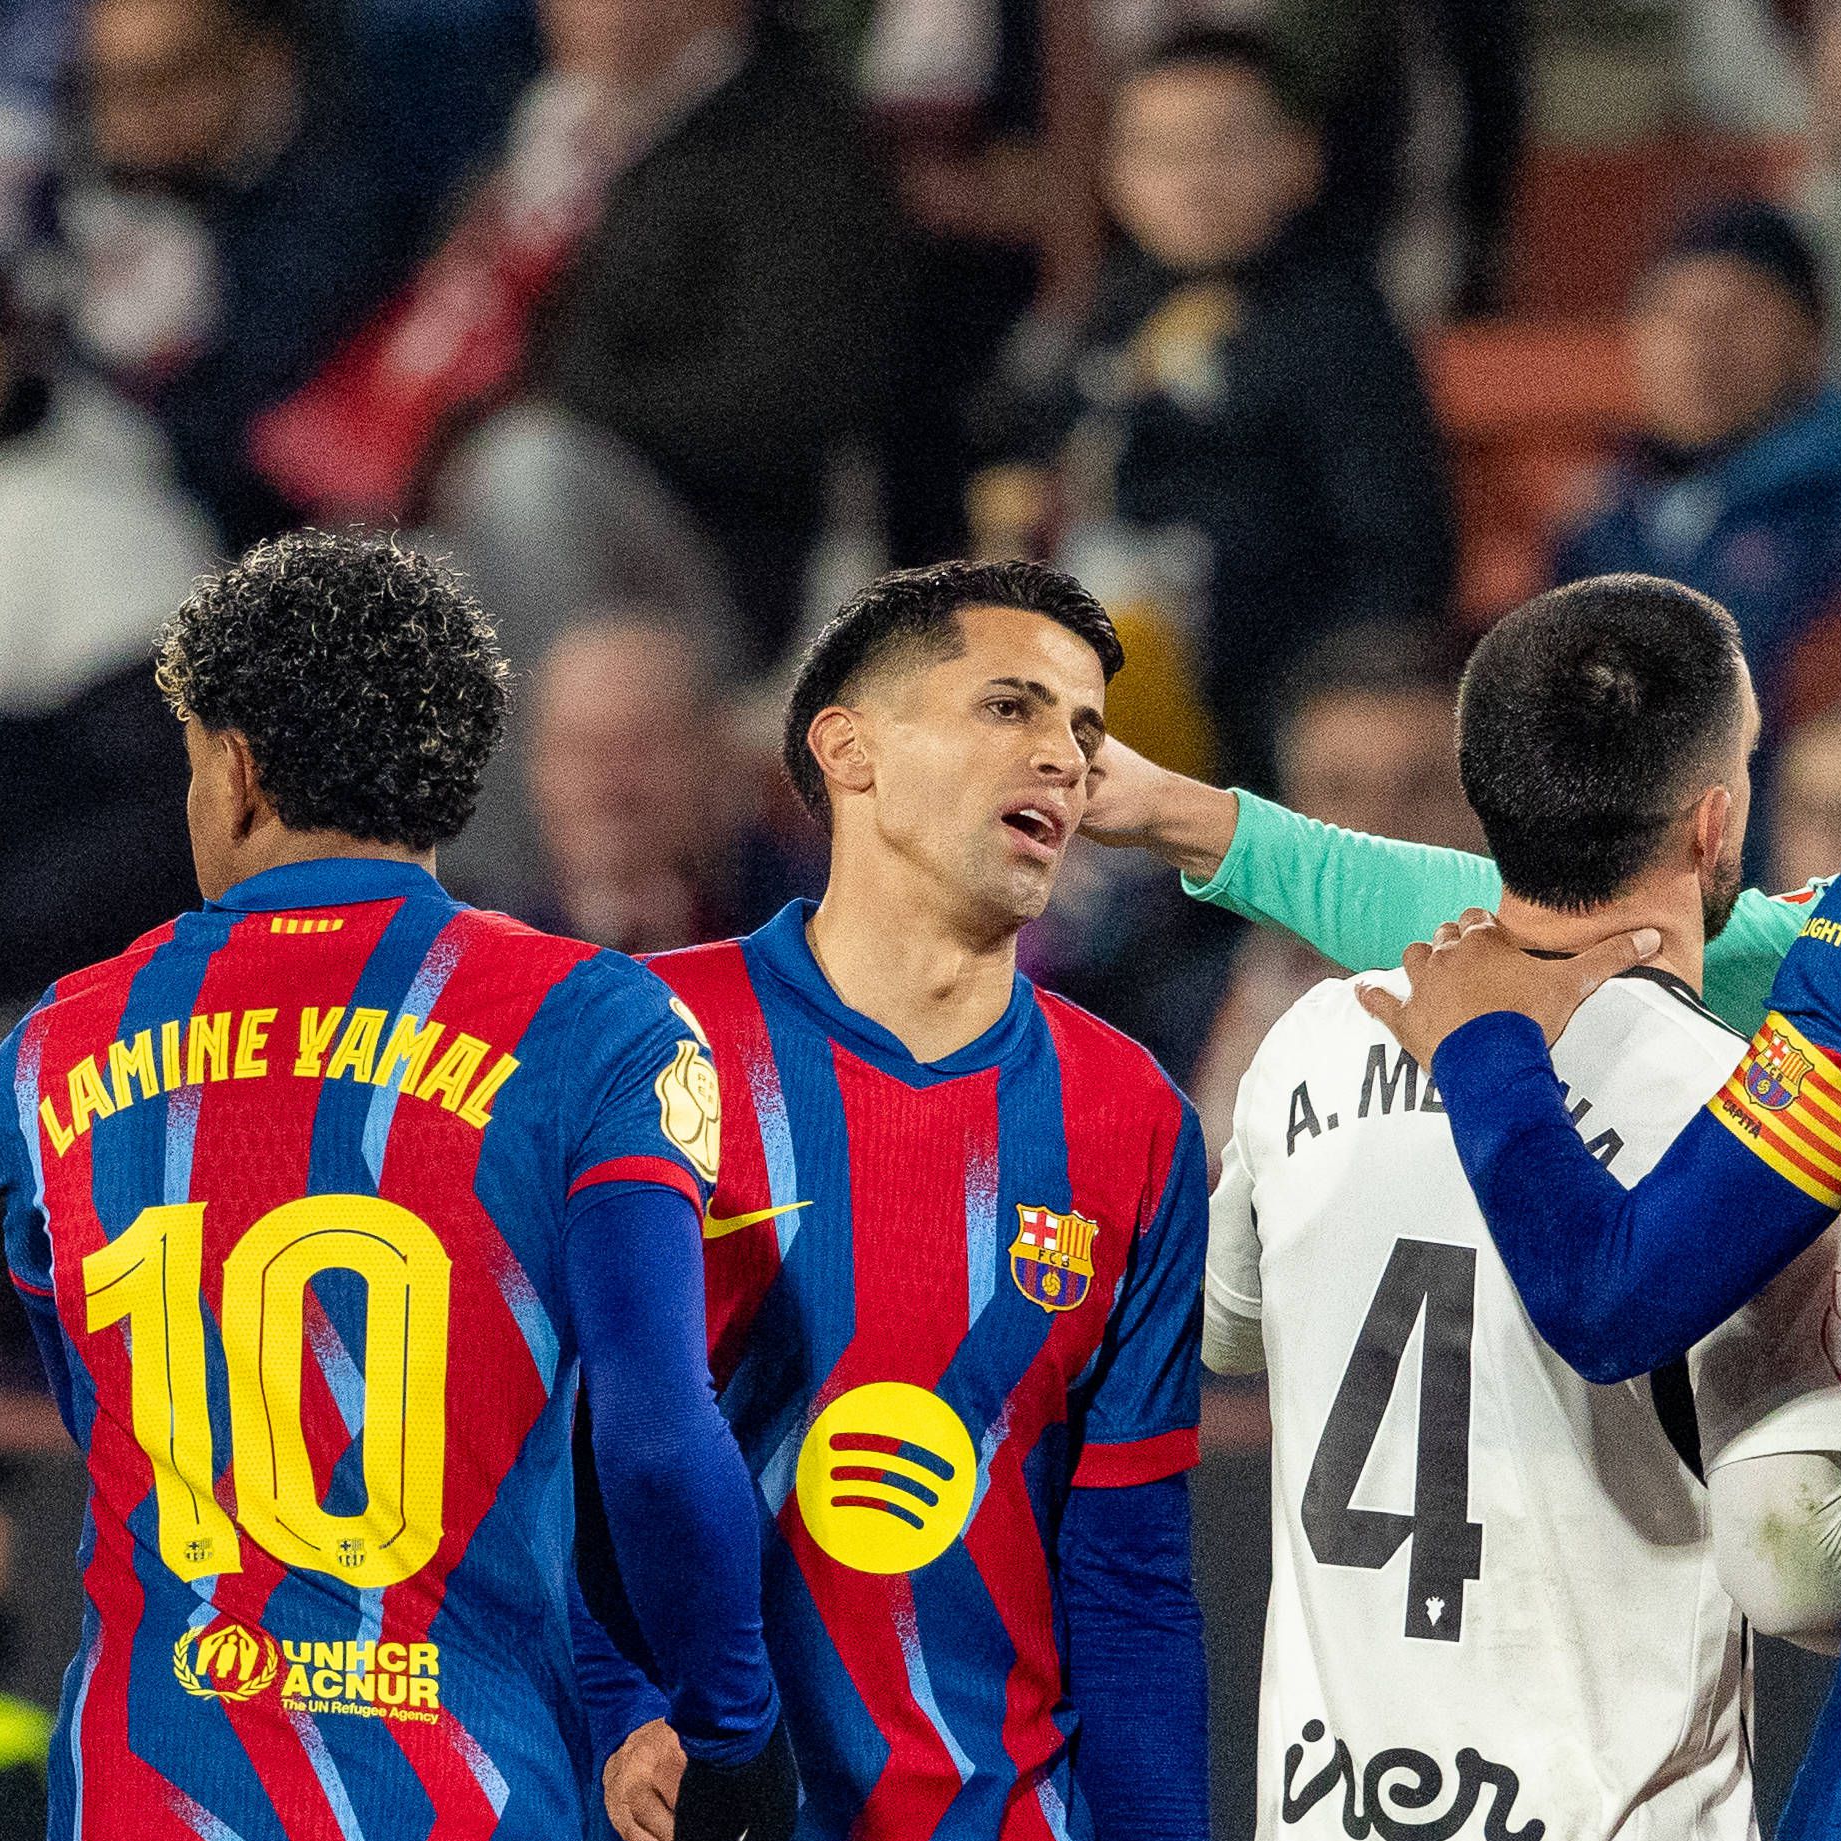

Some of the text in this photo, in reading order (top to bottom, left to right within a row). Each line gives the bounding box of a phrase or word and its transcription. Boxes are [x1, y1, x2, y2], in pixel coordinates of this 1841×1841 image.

[39, 1006, 521, 1158] LAMINE YAMAL
[1287, 1080, 1340, 1157] A.
[82, 1193, 451, 1588] 10
[1300, 1238, 1483, 1643] 4
[281, 1664, 440, 1709] ACNUR
[282, 1639, 440, 1676] UNHCR
[282, 1698, 439, 1725] The UN Refugee Agency
